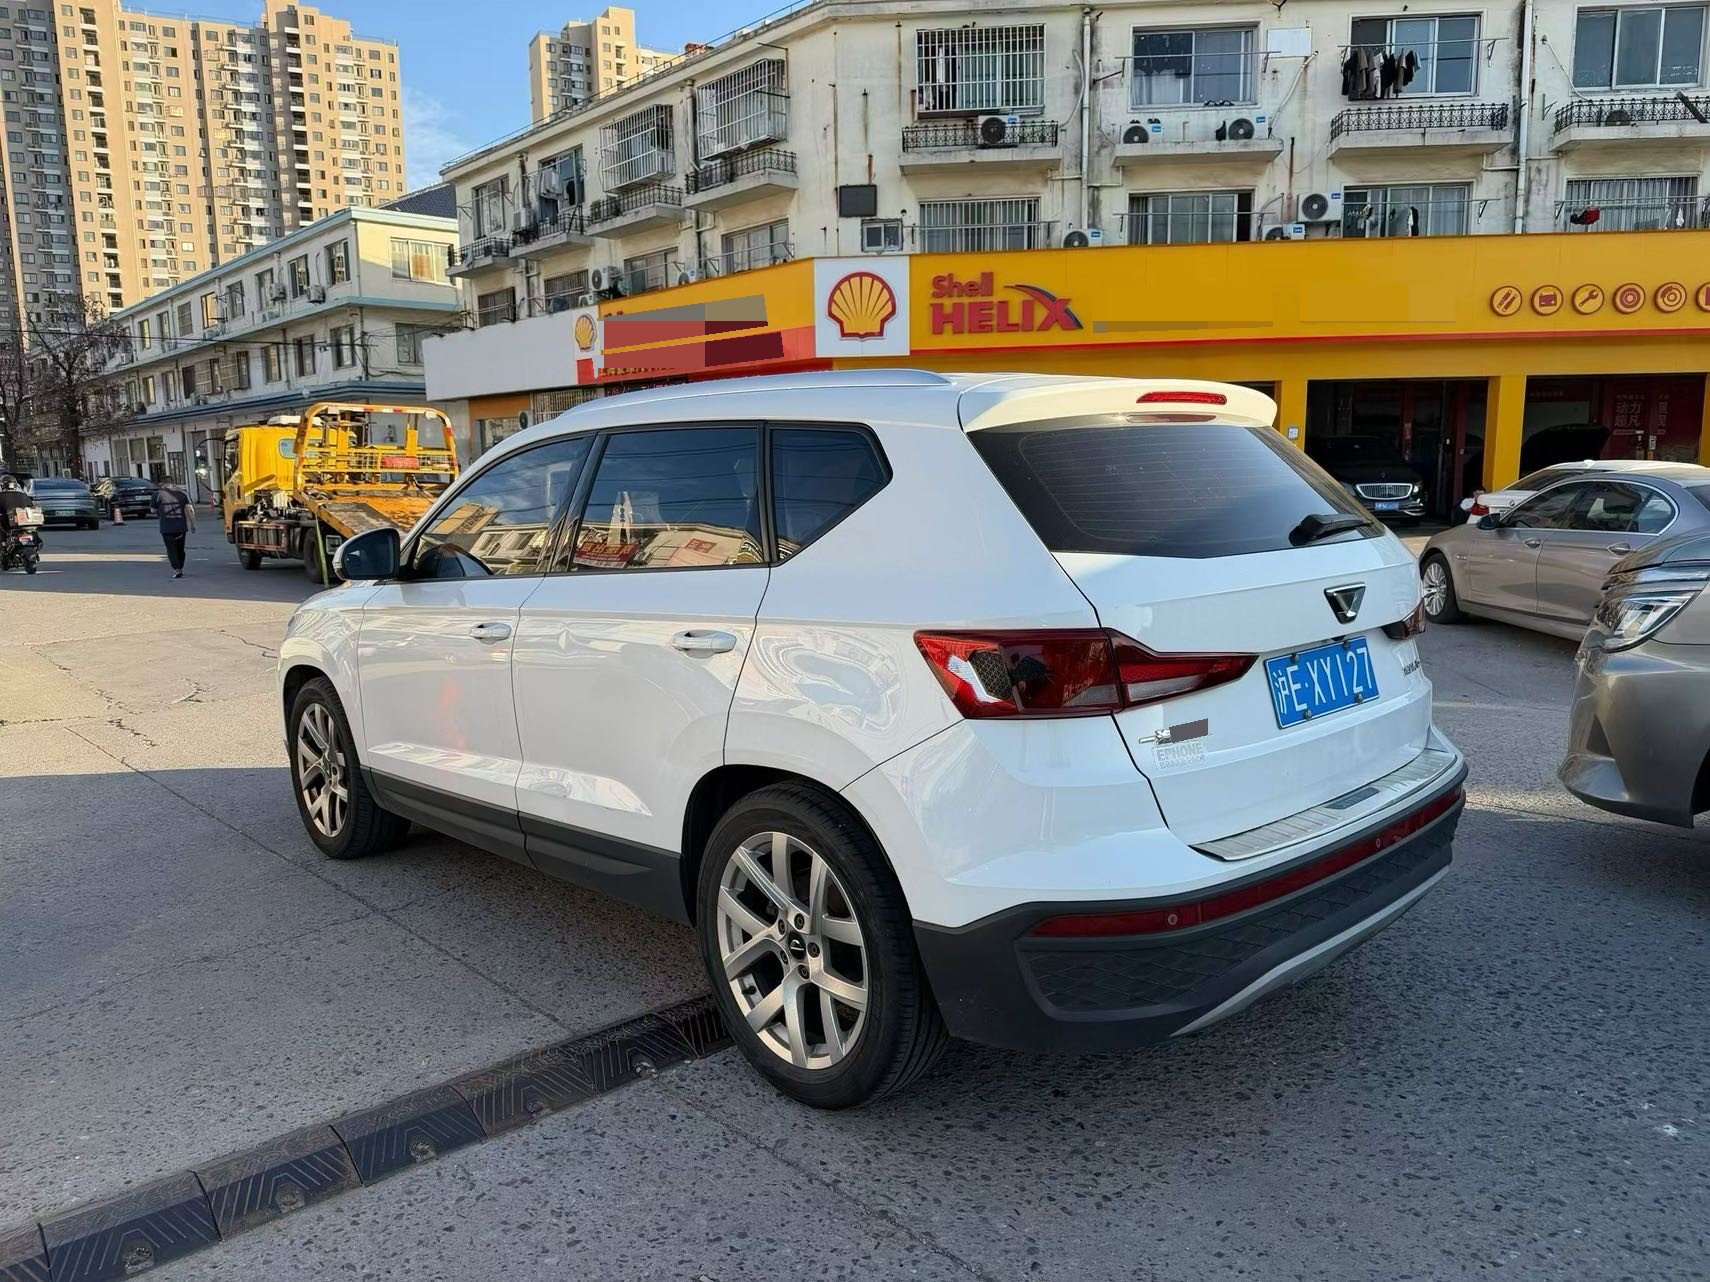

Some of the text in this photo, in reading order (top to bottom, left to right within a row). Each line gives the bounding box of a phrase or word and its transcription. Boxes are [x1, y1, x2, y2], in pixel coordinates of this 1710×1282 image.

[931, 271, 994, 299] Shell
[930, 286, 1083, 335] HELIX
[1615, 401, 1640, 414] 动力
[1156, 742, 1204, 762] EPHONE
